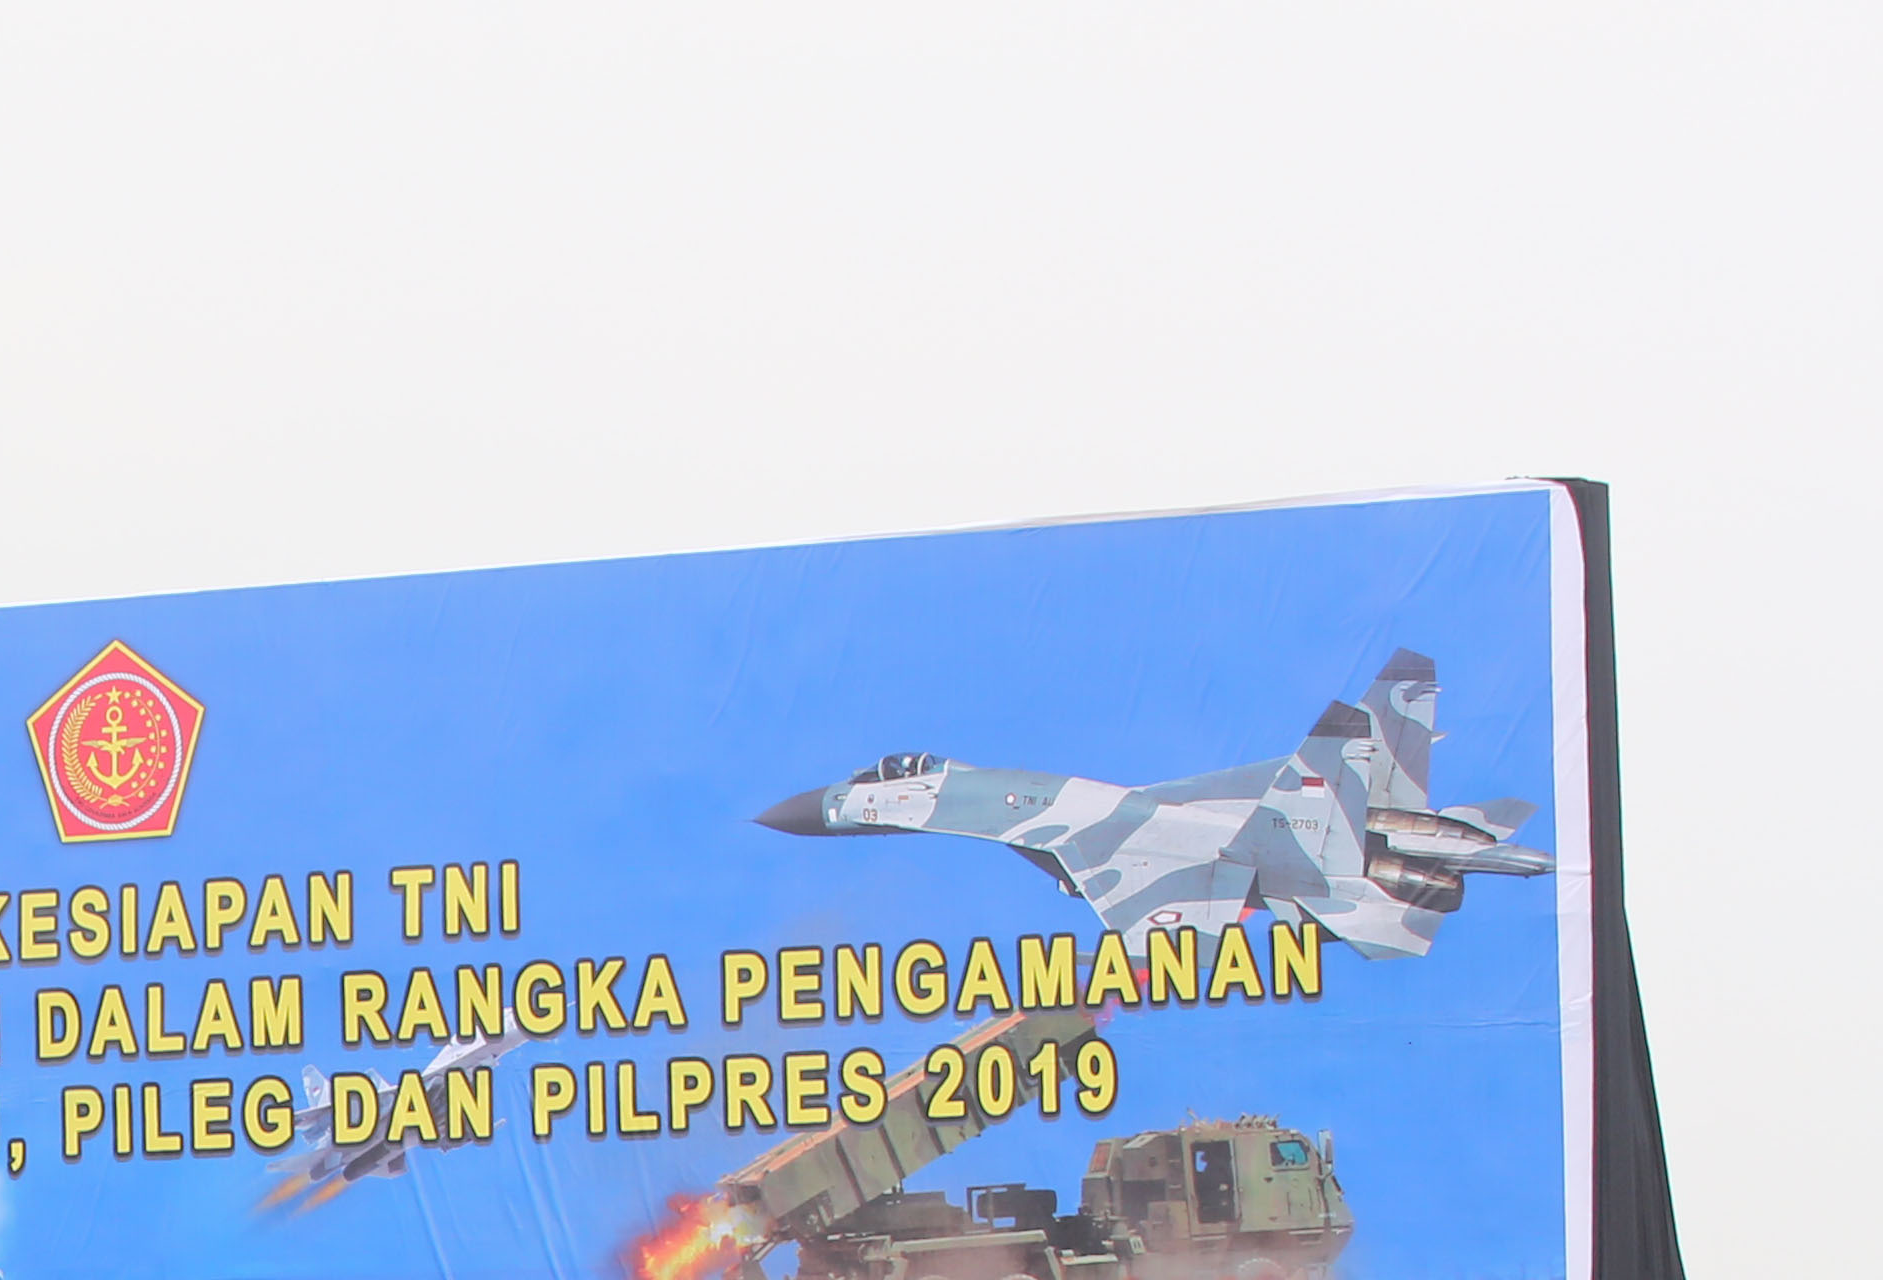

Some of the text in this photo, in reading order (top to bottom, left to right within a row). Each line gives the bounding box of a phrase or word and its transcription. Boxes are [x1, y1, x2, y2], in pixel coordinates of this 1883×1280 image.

[862, 807, 879, 822] 03
[390, 861, 519, 939] TNI
[36, 976, 303, 1060] DALAM
[342, 956, 687, 1044] RANGKA
[722, 921, 1321, 1024] PENGAMANAN
[62, 1077, 294, 1157] PILEG
[332, 1068, 492, 1145] DAN
[532, 1049, 887, 1136] PILPRES
[926, 1039, 1117, 1120] 2019
